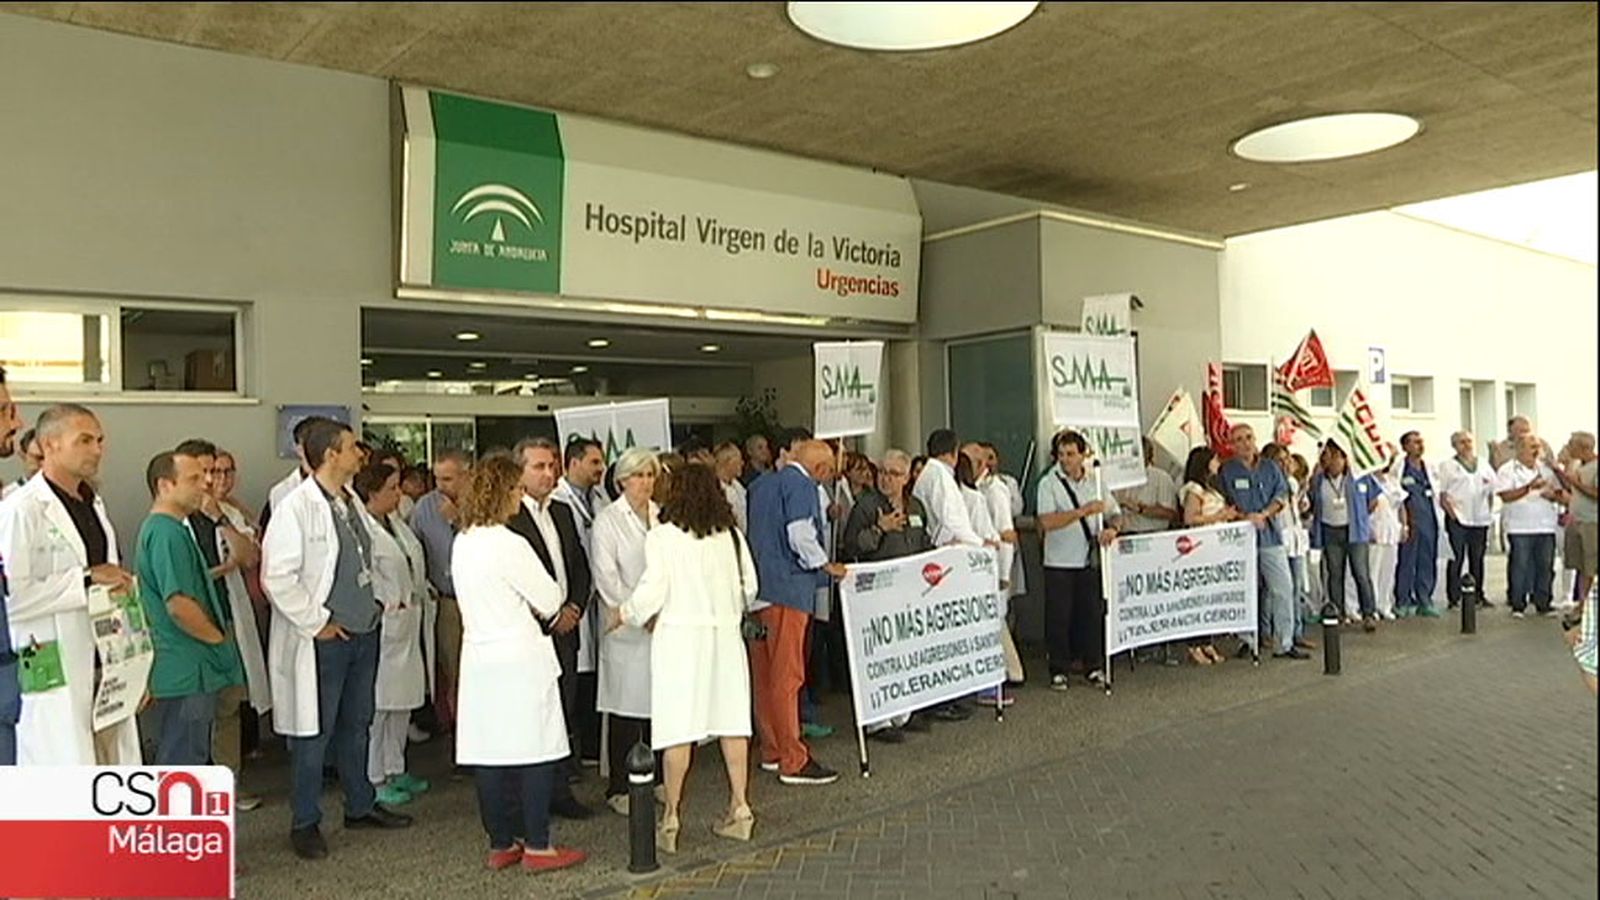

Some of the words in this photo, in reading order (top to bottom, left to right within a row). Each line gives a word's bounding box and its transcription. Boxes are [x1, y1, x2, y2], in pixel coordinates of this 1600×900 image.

[585, 203, 686, 243] Hospital
[696, 217, 765, 254] Virgen
[774, 229, 799, 255] de
[807, 232, 825, 259] la
[832, 236, 901, 268] Victoria
[816, 269, 899, 297] Urgencias
[821, 364, 873, 400] SMA
[1052, 354, 1127, 391] SMA
